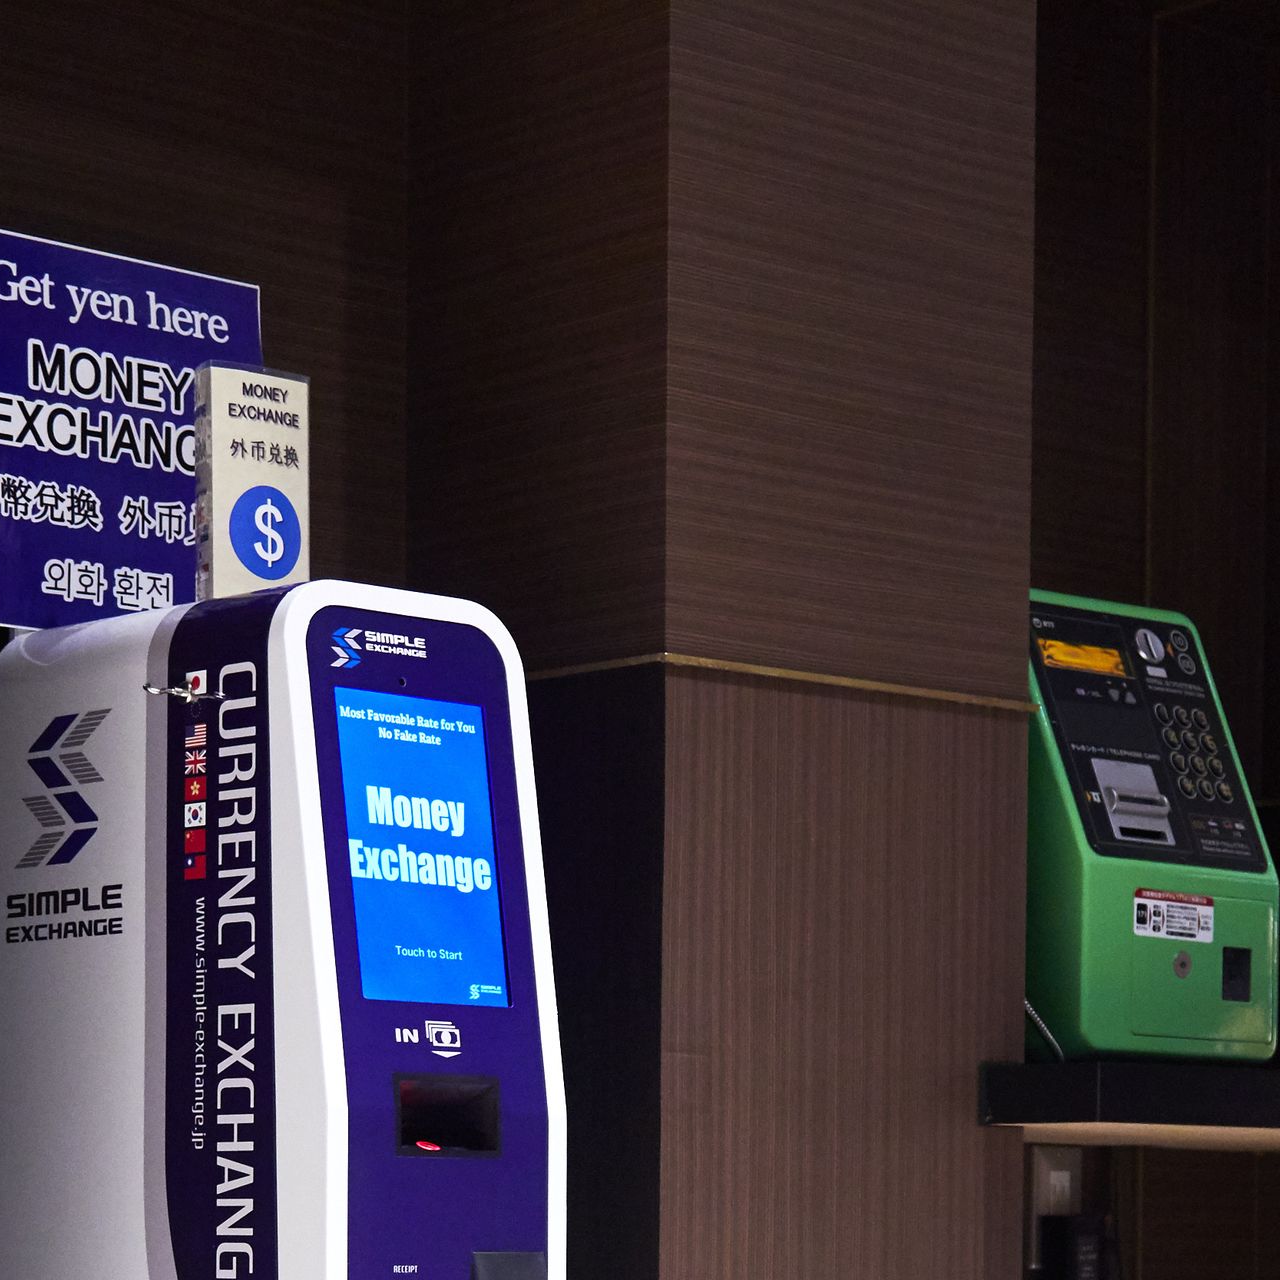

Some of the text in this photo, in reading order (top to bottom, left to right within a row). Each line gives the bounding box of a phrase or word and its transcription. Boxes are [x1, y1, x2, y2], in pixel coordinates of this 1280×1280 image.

[66, 283, 137, 325] yen
[148, 291, 230, 343] here
[29, 340, 194, 413] MONEY
[241, 381, 289, 404] MONEY
[228, 403, 300, 429] EXCHANGE
[230, 438, 300, 469] 外币兑换
[42, 559, 174, 609] 외화 환전
[364, 630, 427, 649] SIMPLE
[365, 643, 427, 659] EXCHANGE
[339, 705, 476, 734] Most Favorable Rate for You
[378, 726, 442, 746] No Fake Rate
[217, 660, 257, 980] CURRENCY
[366, 784, 465, 837] Money
[348, 838, 492, 893] Exchange
[6, 883, 123, 919] SIMPLE
[5, 917, 124, 943] EXCHANGE
[395, 945, 463, 961] Touch to Start
[192, 896, 207, 1151] www.simple-exchange.jp
[394, 1027, 420, 1044] IN
[393, 1264, 418, 1274] RECEIPT
